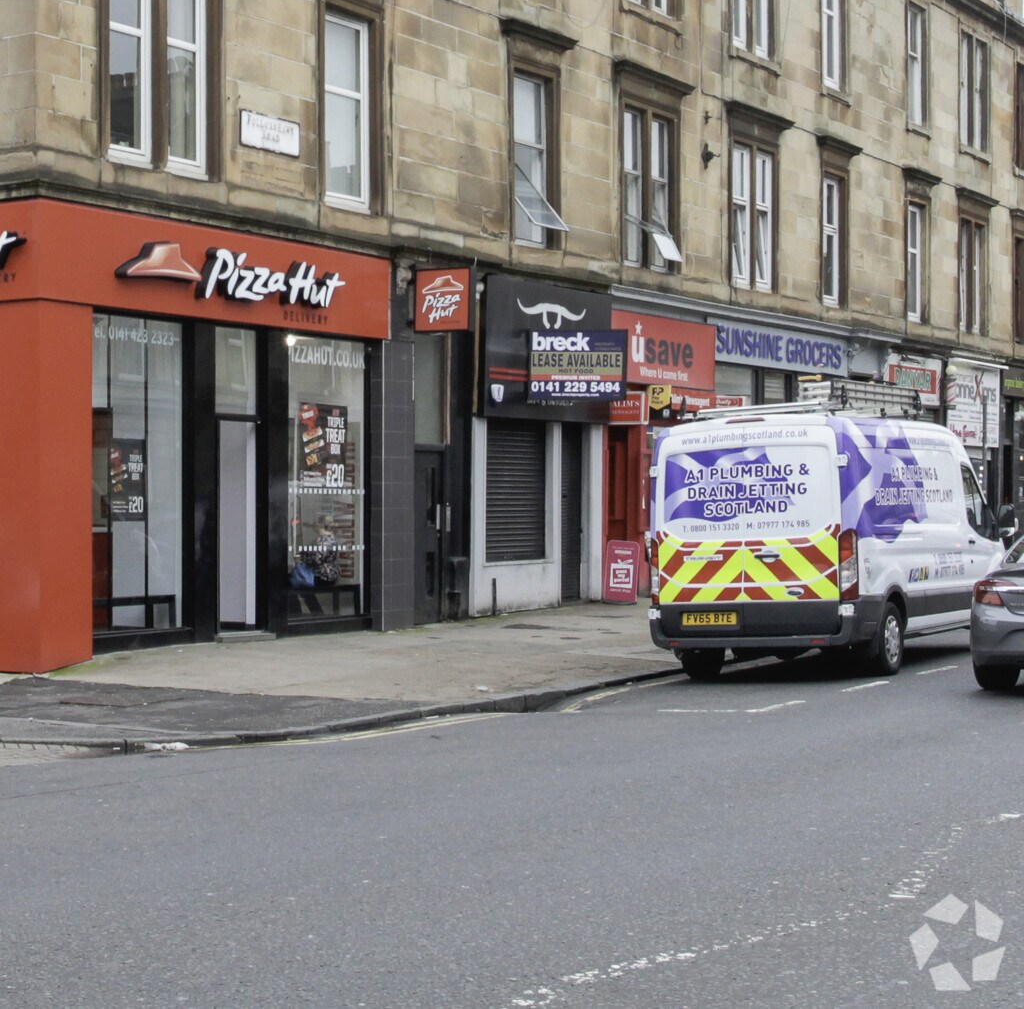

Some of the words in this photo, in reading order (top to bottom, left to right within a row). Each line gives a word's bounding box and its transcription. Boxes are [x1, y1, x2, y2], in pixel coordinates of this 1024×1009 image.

[204, 248, 288, 302] Pizza
[288, 261, 347, 308] Hut
[422, 292, 461, 313] Pizza
[283, 310, 329, 325] DELIVERY
[428, 303, 459, 323] Hut
[108, 325, 128, 341] 0141
[130, 329, 148, 343] 423
[151, 330, 174, 346] 2323
[532, 332, 590, 351] breck
[631, 335, 694, 369] usave
[716, 324, 784, 362] SUNSHINE
[785, 337, 842, 370] GROCERS
[532, 353, 564, 367] LEASE
[567, 353, 621, 368] AVAILABLE
[640, 366, 657, 377] Where
[663, 371, 677, 380] come
[678, 371, 688, 382] first
[531, 381, 560, 392] 0141
[564, 381, 587, 392] 229
[590, 381, 621, 393] 5494
[327, 416, 345, 428] TRIPLE
[325, 428, 346, 444] TREAT
[681, 429, 809, 445] www.a1plumbingscotland.co.uk
[330, 443, 341, 455] BOX
[129, 454, 143, 463] TRIPLE
[128, 462, 144, 473] TREAT
[325, 463, 345, 488] £20
[686, 470, 704, 482] A1
[710, 463, 794, 480] PLUMBING
[799, 463, 810, 475] &
[901, 465, 933, 481] PLUMBING
[687, 484, 737, 499] DRAIN
[739, 482, 808, 498] JETTING
[876, 488, 898, 505] DRAIN
[899, 487, 925, 505] JETTING
[925, 488, 953, 503] SCOTLAND
[128, 495, 144, 513] £20
[704, 500, 788, 516] SCOTLAND
[690, 524, 707, 532] 0800
[709, 523, 721, 531] 151
[723, 523, 740, 531] 3320
[746, 522, 756, 530] M:
[757, 521, 779, 529] 07977
[782, 520, 795, 528] 174
[796, 519, 810, 528] 985
[686, 614, 711, 624] FV65
[713, 613, 733, 623] BTE
